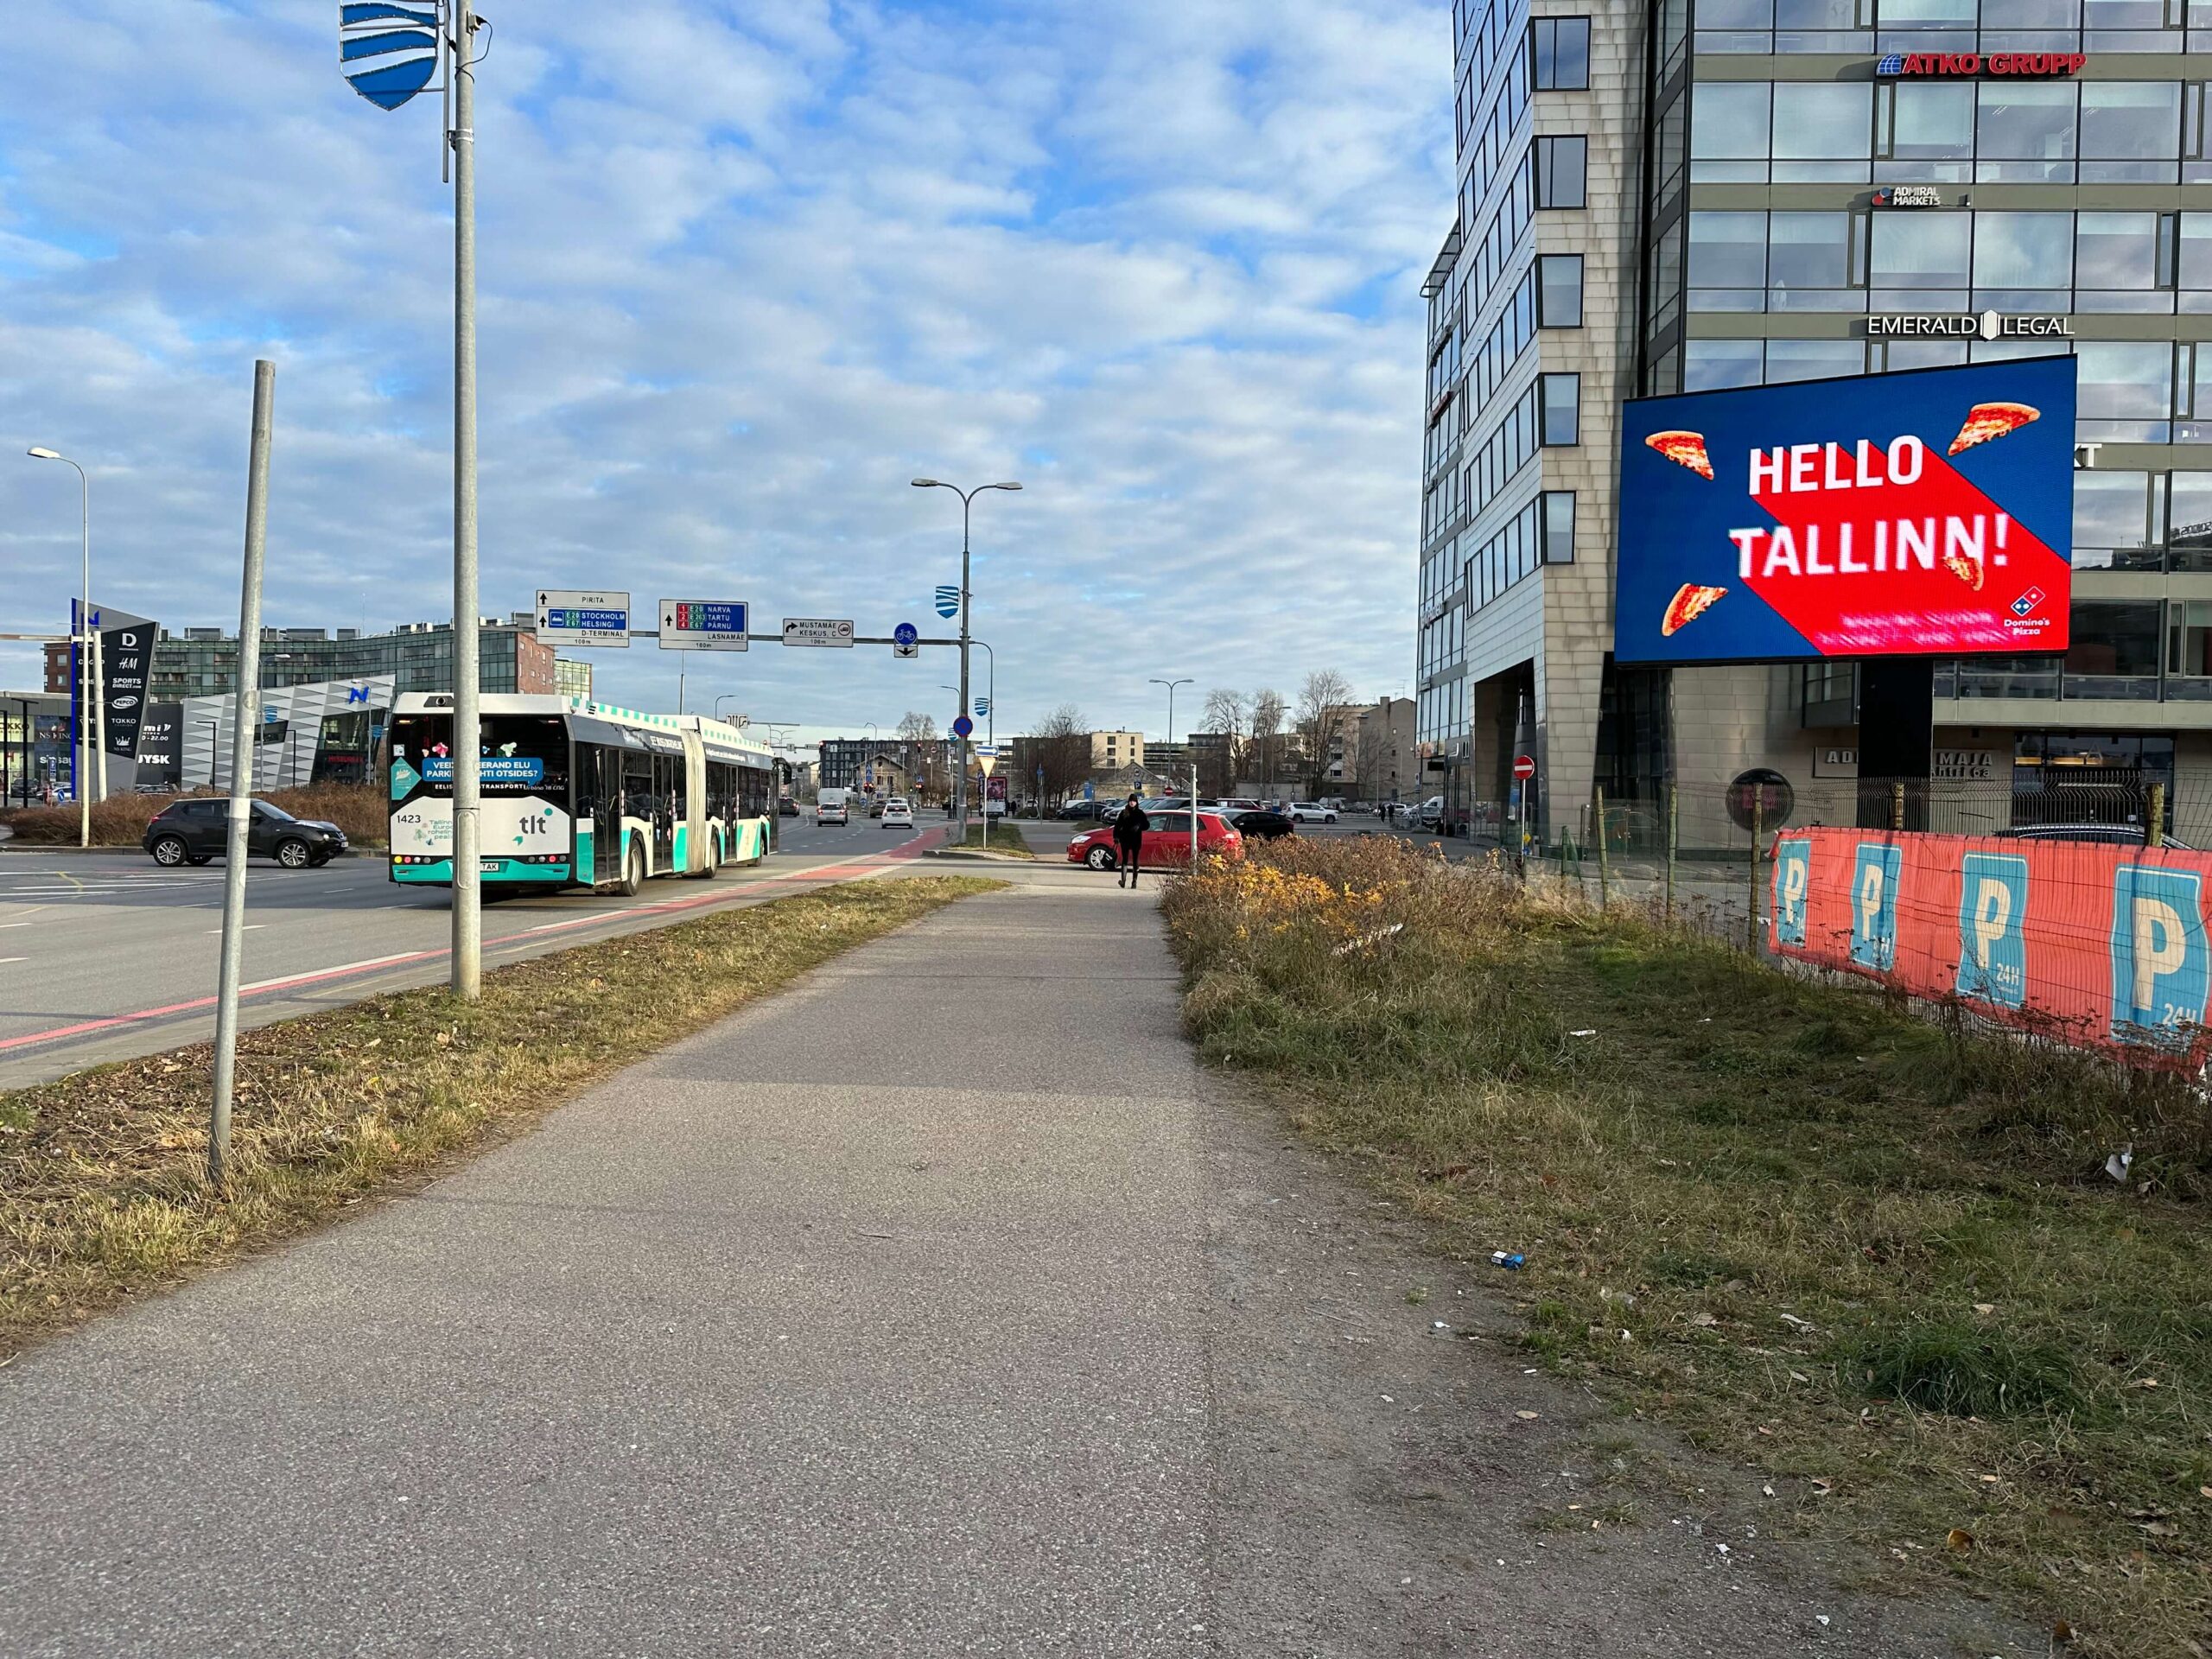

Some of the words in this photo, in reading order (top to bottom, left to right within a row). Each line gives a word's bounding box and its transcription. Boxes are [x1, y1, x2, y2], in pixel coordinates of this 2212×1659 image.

[1902, 54, 1980, 75] ATKO
[1989, 54, 2087, 74] GRUPP
[1894, 187, 1939, 197] ADMIRAL
[1893, 196, 1941, 206] MARKETS
[1868, 316, 1977, 334] EMERALD
[2003, 317, 2075, 334] LEGAL
[1749, 435, 1923, 496] HELLO
[1728, 512, 2010, 579] TALLINN!
[582, 612, 625, 620] STOCKHOLM
[2003, 617, 2051, 628] Domino's
[122, 632, 137, 647] D
[2012, 627, 2041, 636] Pizza
[118, 658, 138, 670] H&M
[138, 754, 169, 765] JYSK
[1939, 753, 1993, 766] MAJA
[397, 814, 422, 823] 1423
[518, 815, 546, 835] tlt
[1784, 858, 1805, 925] P
[1861, 864, 1883, 941] P
[1975, 878, 2011, 968] P
[2133, 898, 2187, 1012] P
[1996, 963, 2020, 986] 24H
